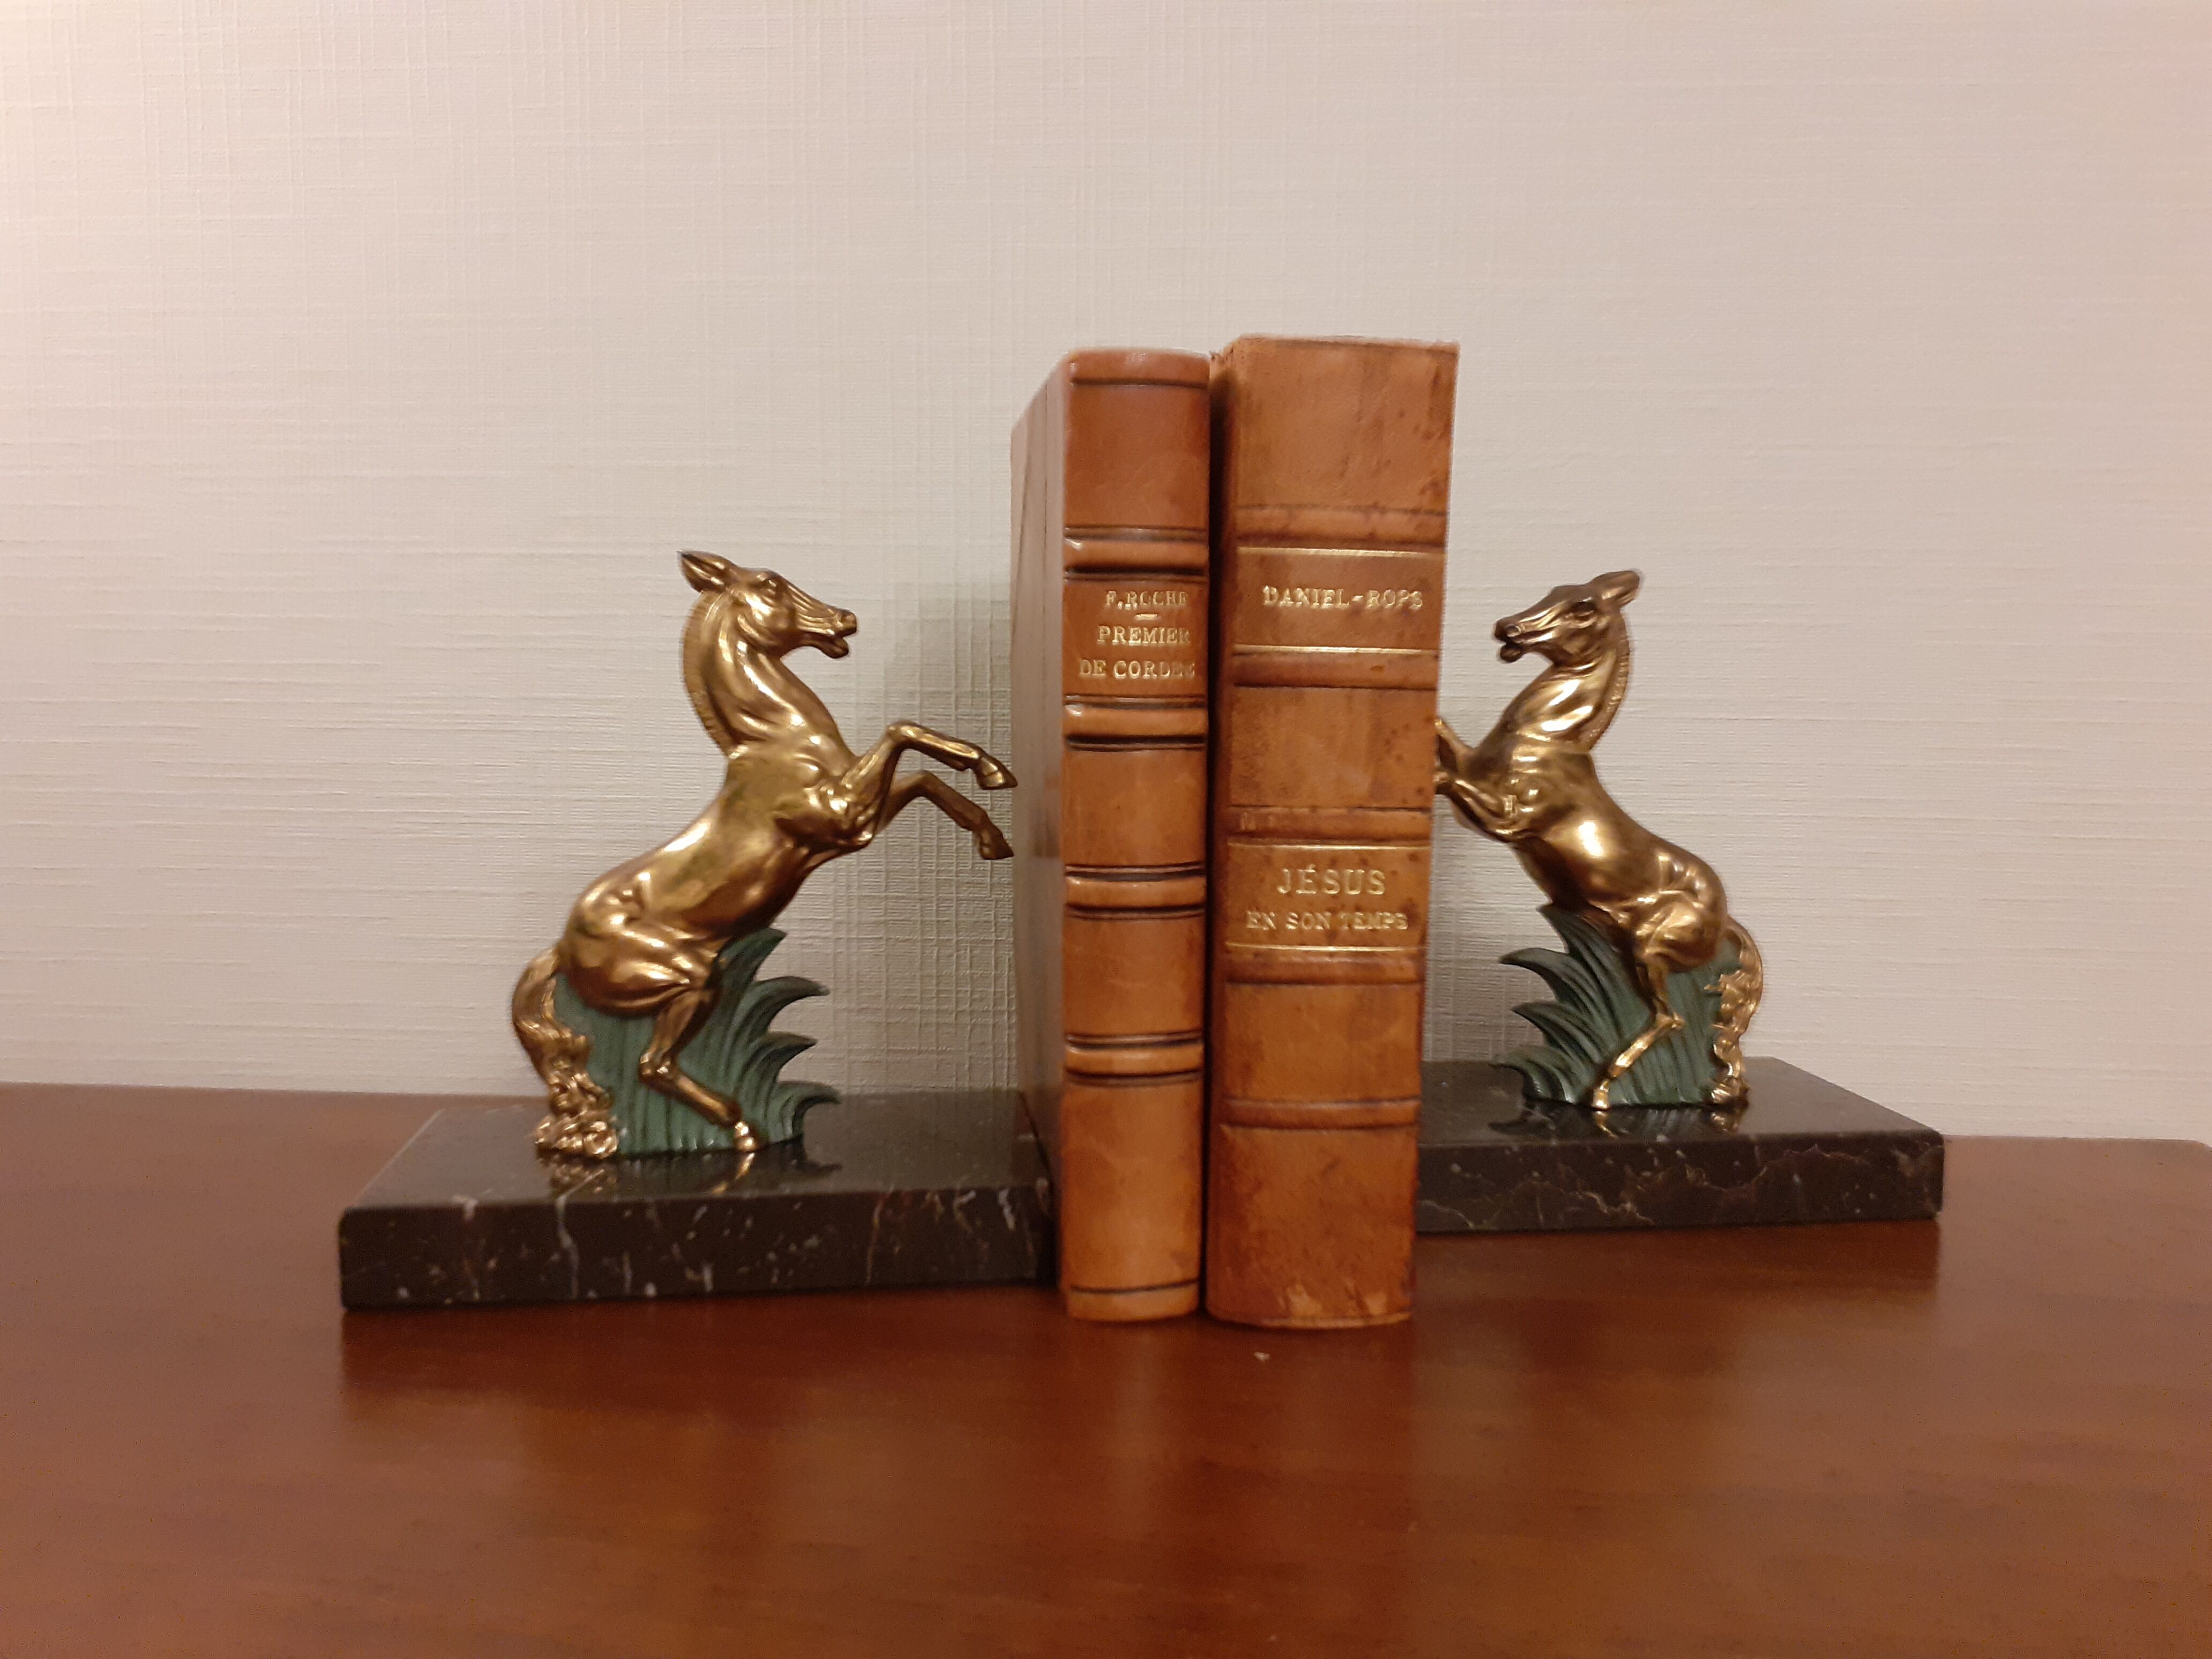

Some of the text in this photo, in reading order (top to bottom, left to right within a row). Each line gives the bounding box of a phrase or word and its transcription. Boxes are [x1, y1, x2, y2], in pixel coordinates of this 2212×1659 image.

[1262, 586, 1423, 610] DANIEL-ROPS
[1097, 625, 1191, 645] PREMIER
[1079, 659, 1107, 677] DE
[1277, 863, 1386, 895] JÉSUS
[1246, 910, 1408, 930] EN SON TEMPS
